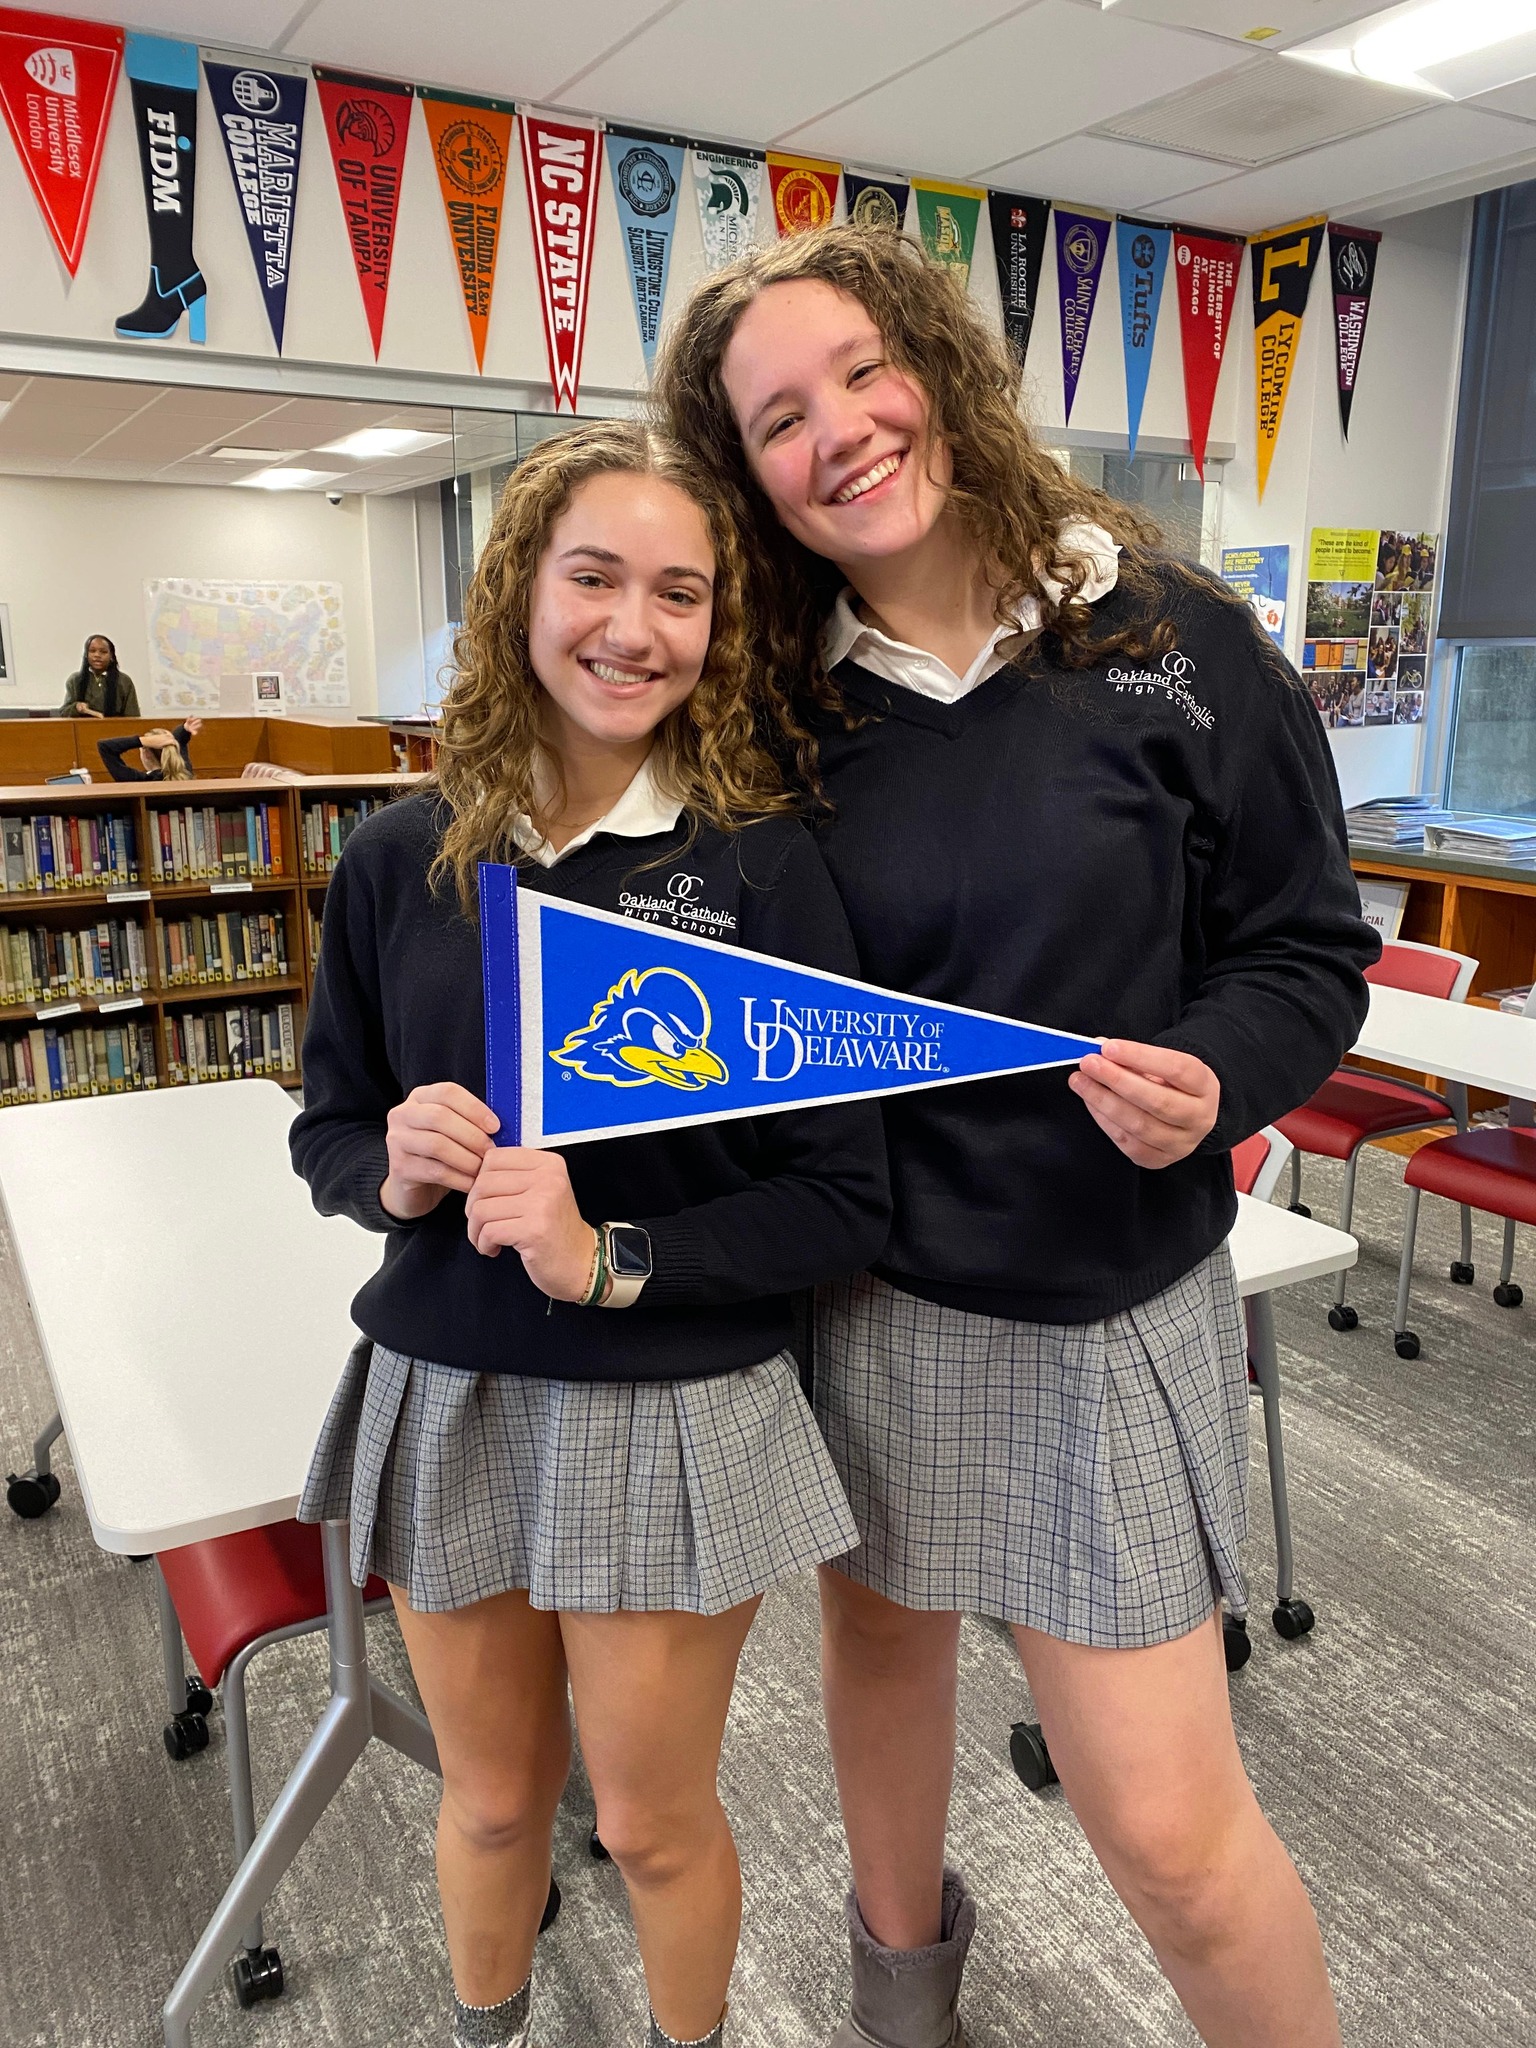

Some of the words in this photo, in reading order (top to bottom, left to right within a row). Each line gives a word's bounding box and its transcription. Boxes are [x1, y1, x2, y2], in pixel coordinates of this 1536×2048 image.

[25, 93, 43, 149] London
[45, 96, 65, 175] University
[62, 97, 82, 179] Middlesex
[147, 108, 182, 214] FIDM
[222, 113, 261, 226] COLLEGE
[338, 158, 366, 191] OF
[537, 131, 585, 194] NC
[696, 151, 759, 170] ENGINEERING
[253, 119, 297, 288] MARIETTA
[370, 164, 397, 290] UNIVERSITY
[346, 199, 372, 277] TAMPA
[447, 200, 480, 316] UNIVERSITY
[477, 203, 498, 274] FLORIDA
[544, 202, 581, 333] STATE
[627, 226, 646, 274] SALISBURY,
[645, 229, 669, 297] LIVINGSTONE
[1018, 233, 1027, 253] LA
[1201, 258, 1209, 274] AT
[477, 278, 489, 317] A&M
[636, 276, 648, 303] NORTH
[1010, 233, 1019, 308] UNIVERSITY
[1018, 257, 1027, 309] ROCHE
[1075, 276, 1094, 314] SAINT
[1191, 255, 1200, 315] CHICAGO
[1207, 259, 1217, 317] ILLINOIS
[1225, 262, 1234, 288] THE
[1260, 236, 1310, 302] L
[639, 305, 648, 343] CAROLINA
[647, 300, 661, 342] COLLEGE
[1064, 298, 1076, 351] COLLEGE
[1132, 271, 1154, 348] Tufts
[1214, 261, 1225, 342] UNIVERSITY
[1071, 314, 1088, 376] MICHAEL'S
[1213, 342, 1221, 360] OF
[1338, 314, 1350, 371] COLLEGE
[1345, 301, 1366, 386] WASHINGTON
[1260, 334, 1277, 431] COLLEGE
[1266, 321, 1296, 439] LYCOMING
[1107, 668, 1172, 686] Oakland
[1175, 681, 1216, 727] Catholic
[1115, 683, 1155, 695] High
[1166, 690, 1201, 731] School
[619, 892, 677, 911] Oakland
[680, 903, 737, 926] Catholic
[624, 907, 660, 921] High
[671, 915, 723, 937] School
[739, 997, 920, 1051] UNIVERSITY
[920, 1022, 945, 1039] OF
